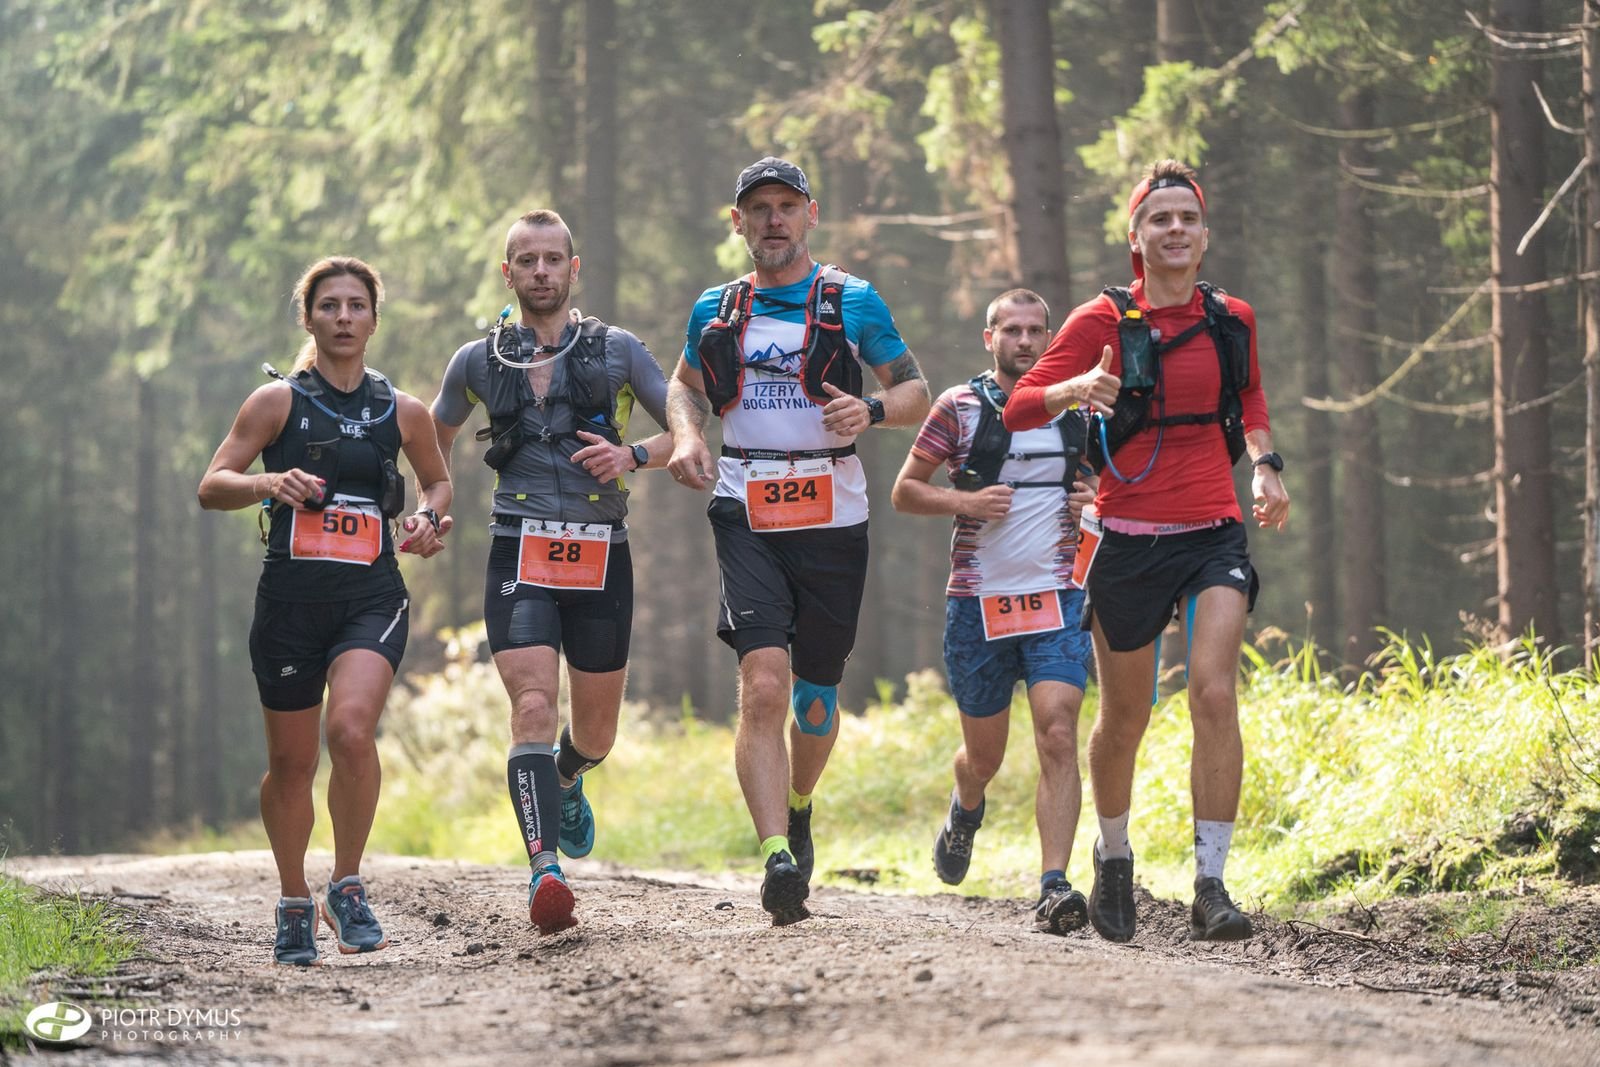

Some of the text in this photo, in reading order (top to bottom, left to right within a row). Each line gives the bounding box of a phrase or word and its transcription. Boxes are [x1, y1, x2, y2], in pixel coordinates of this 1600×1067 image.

[755, 385, 797, 397] IZERY
[743, 398, 817, 410] BOGATYNIA
[764, 480, 818, 504] 324
[322, 512, 358, 535] 50
[548, 541, 581, 563] 28
[998, 593, 1042, 614] 316
